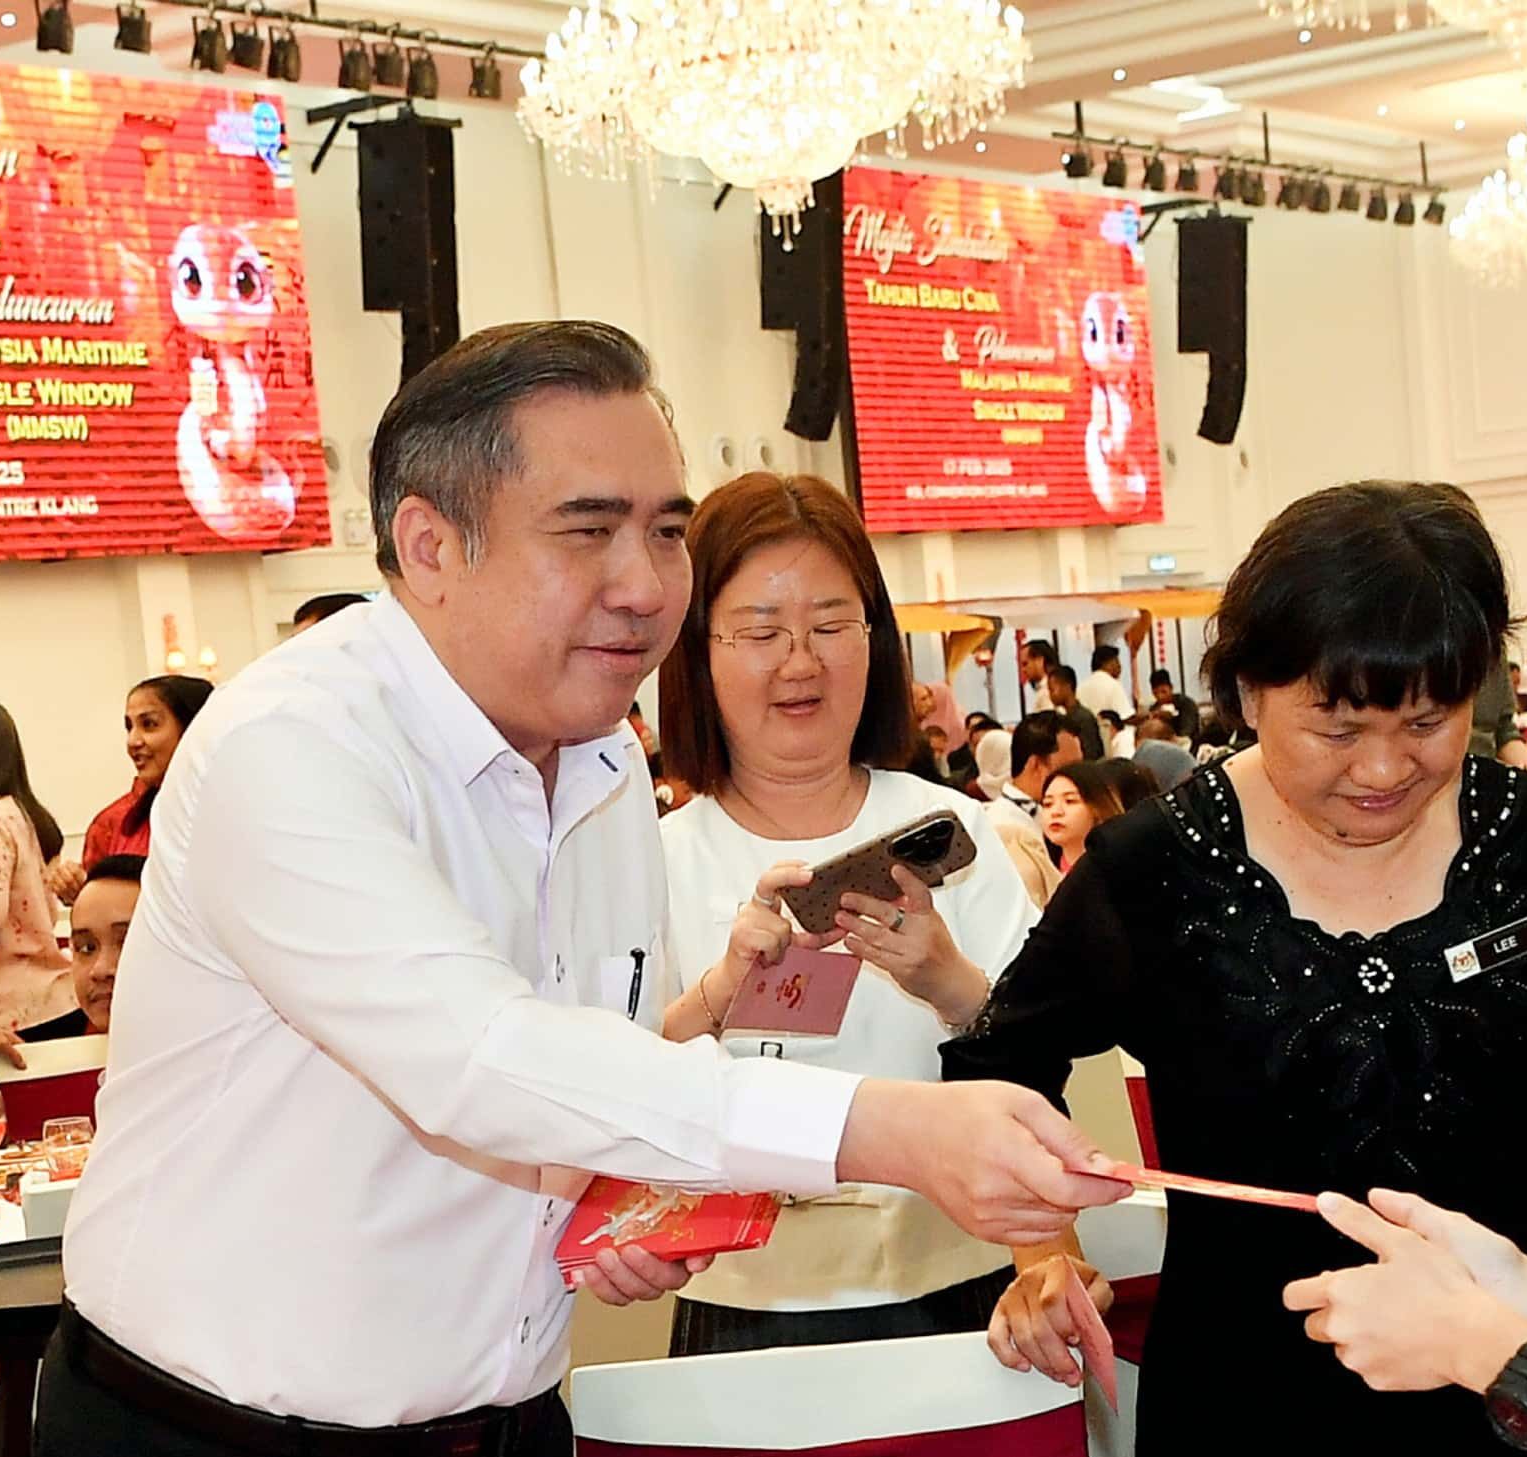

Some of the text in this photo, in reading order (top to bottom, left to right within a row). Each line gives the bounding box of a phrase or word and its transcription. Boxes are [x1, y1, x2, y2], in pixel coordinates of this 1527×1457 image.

[40, 336, 150, 366] MARITIME
[34, 378, 135, 407] WINDOW
[1493, 935, 1519, 954] LEE
